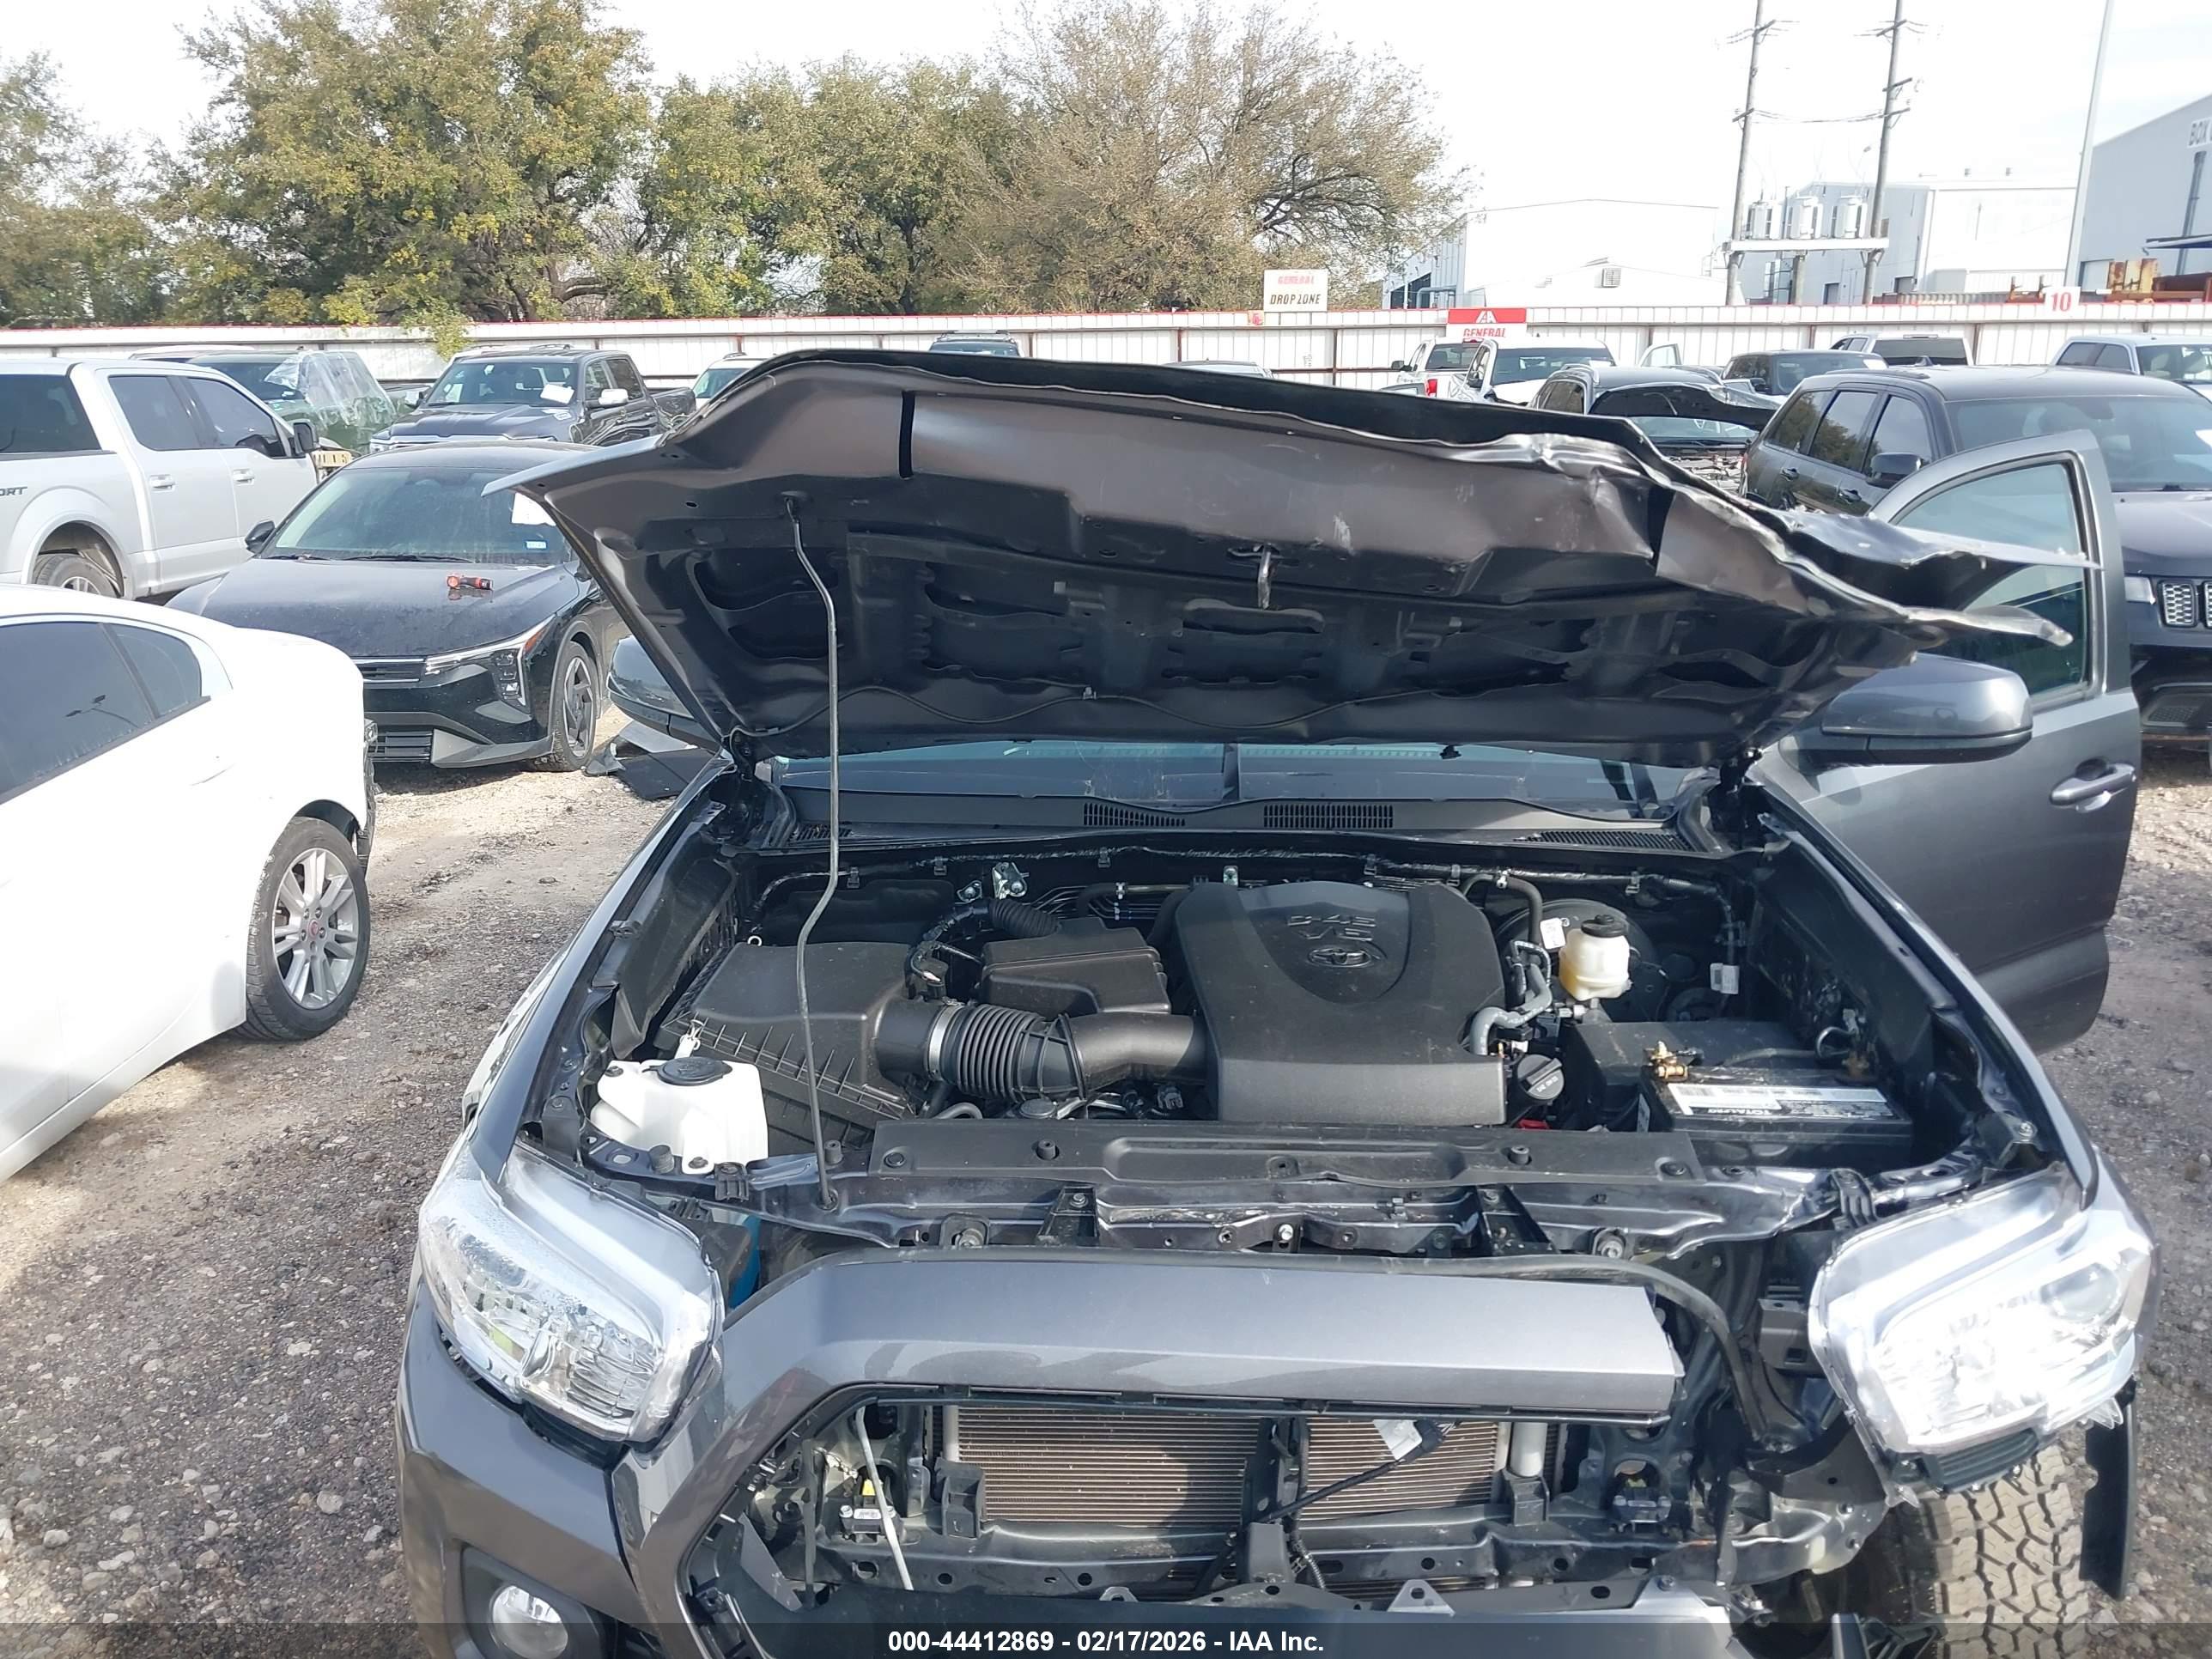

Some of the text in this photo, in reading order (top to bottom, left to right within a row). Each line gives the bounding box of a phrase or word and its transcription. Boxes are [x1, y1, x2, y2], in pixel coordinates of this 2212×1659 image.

[1270, 294, 1322, 305] DROP ZONE
[2051, 292, 2071, 312] 10
[1463, 328, 1506, 337] GENERAL
